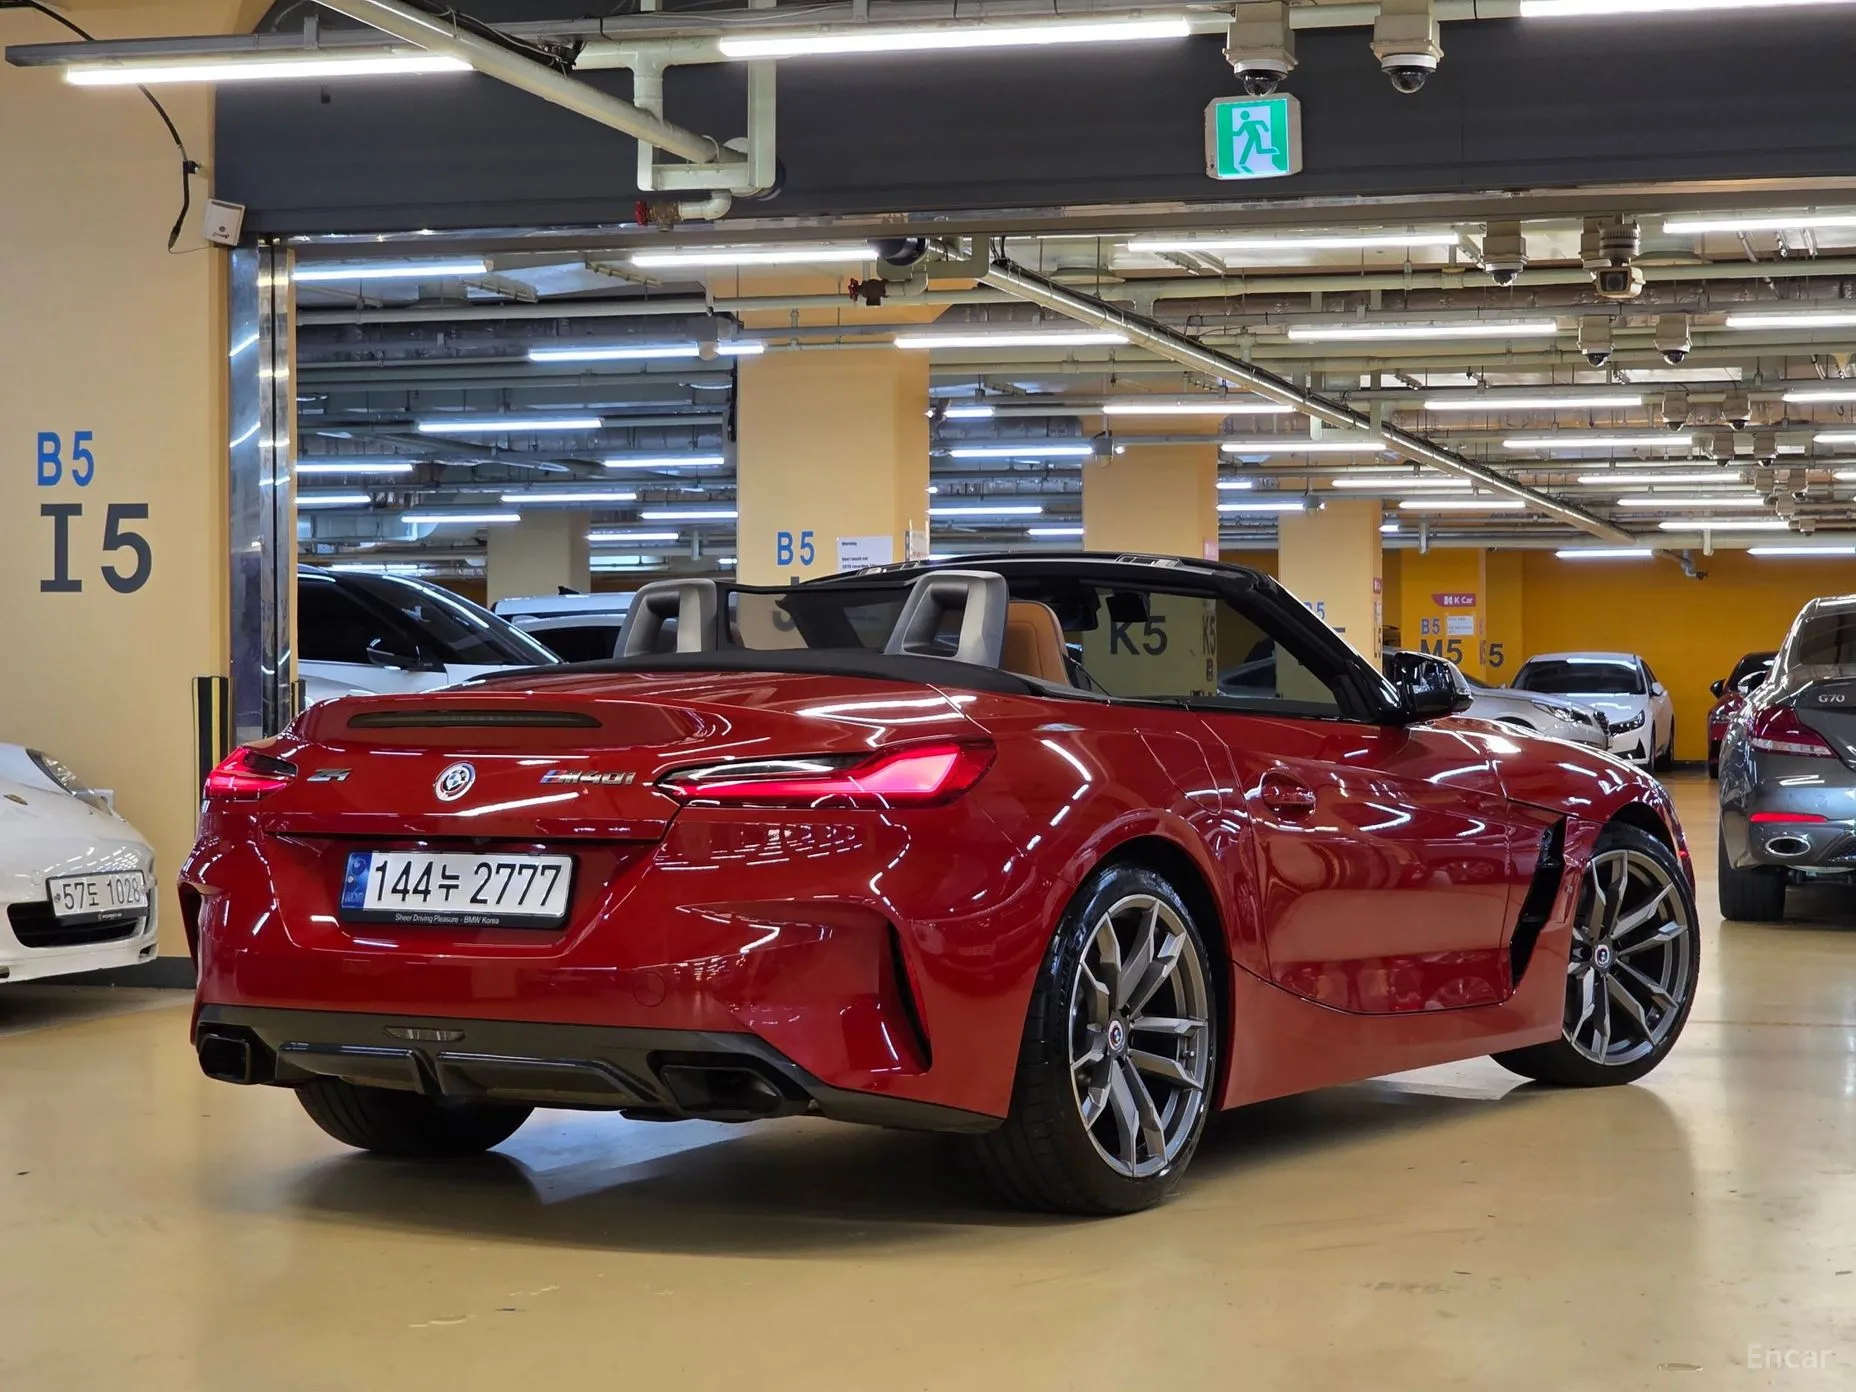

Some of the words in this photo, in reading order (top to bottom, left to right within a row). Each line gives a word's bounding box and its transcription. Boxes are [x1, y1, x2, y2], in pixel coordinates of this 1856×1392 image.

[37, 431, 94, 487] B5
[40, 503, 152, 594] I5
[777, 531, 815, 566] B5
[1110, 616, 1168, 656] K5
[1421, 618, 1440, 635] B5
[1420, 639, 1463, 665] M5
[1818, 694, 1846, 703] G70
[107, 877, 141, 905] 1028
[375, 860, 461, 903] 144누
[469, 862, 562, 907] 2777
[395, 913, 412, 921] Sheer
[412, 914, 433, 924] Driving
[433, 915, 459, 923] Pleasure
[464, 916, 481, 924] BMW
[481, 917, 500, 925] Korea
